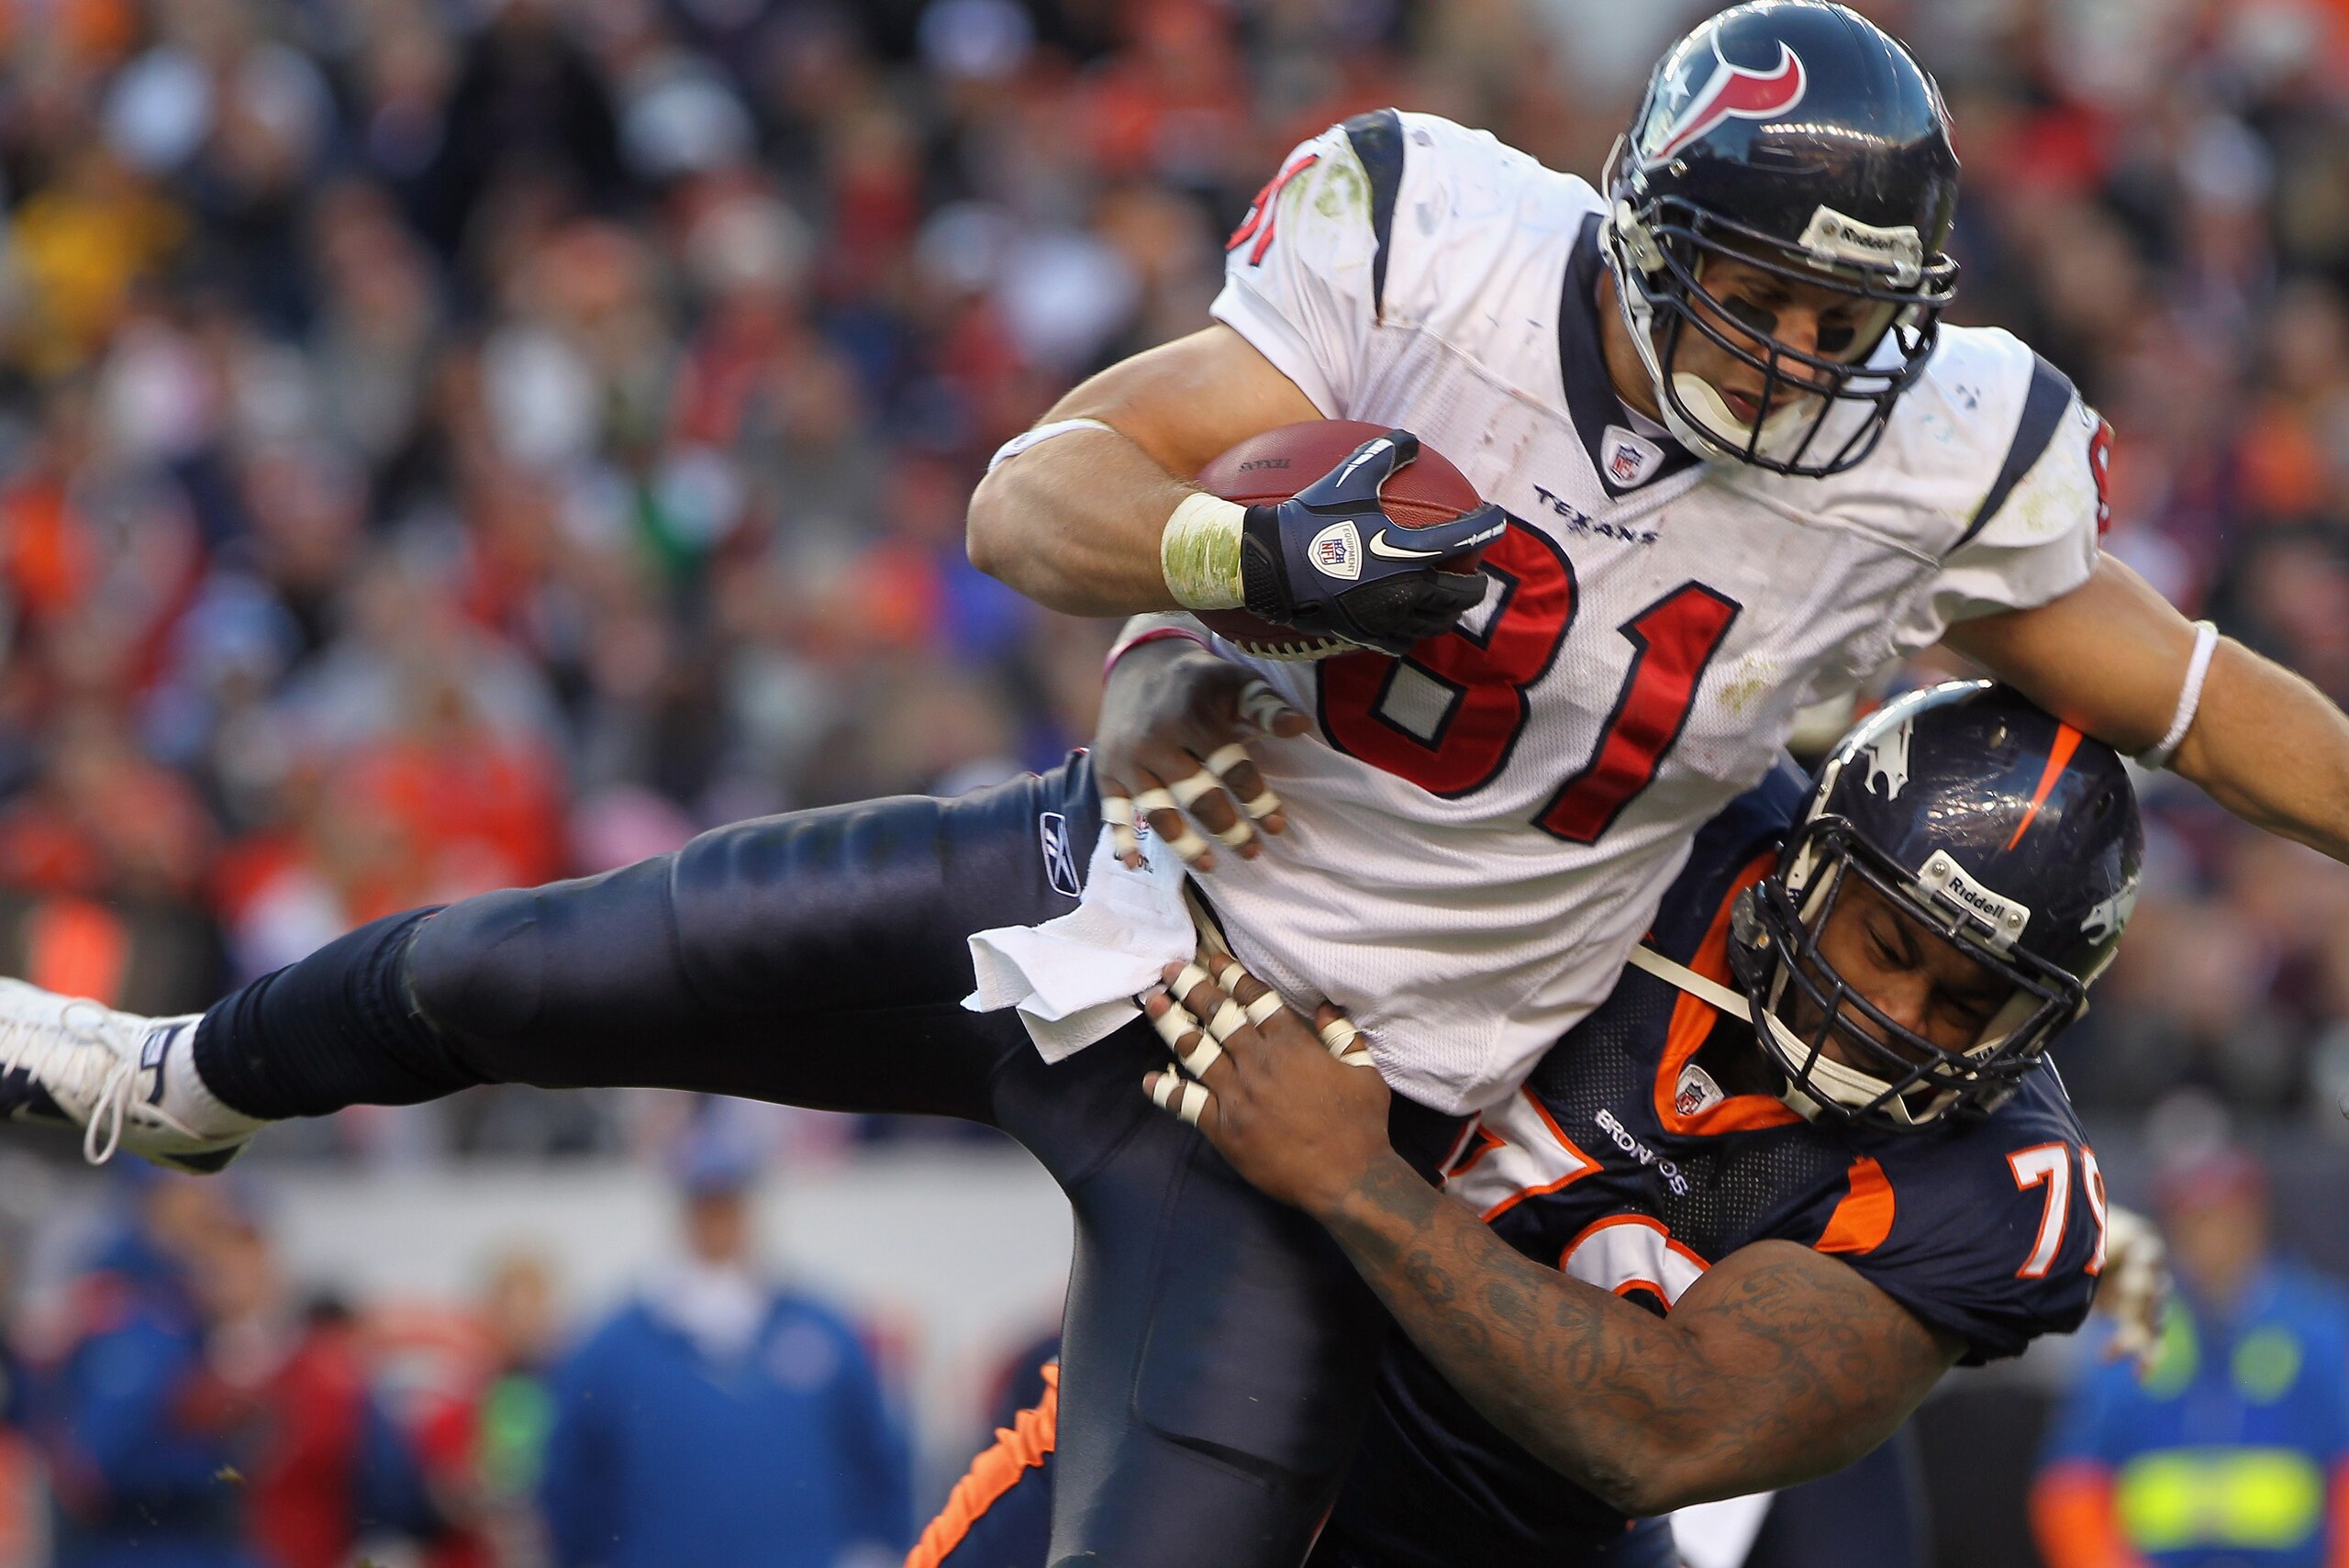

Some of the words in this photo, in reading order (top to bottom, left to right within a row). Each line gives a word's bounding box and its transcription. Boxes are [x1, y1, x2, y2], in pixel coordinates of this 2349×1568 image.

[1533, 484, 1659, 545] TEXANS
[1321, 542, 1335, 562] NFL
[1342, 528, 1356, 573] EQUIPMENT
[1316, 501, 1743, 848] 81
[1948, 876, 2005, 919] Riddell
[1595, 1107, 1688, 1196] BRONOS
